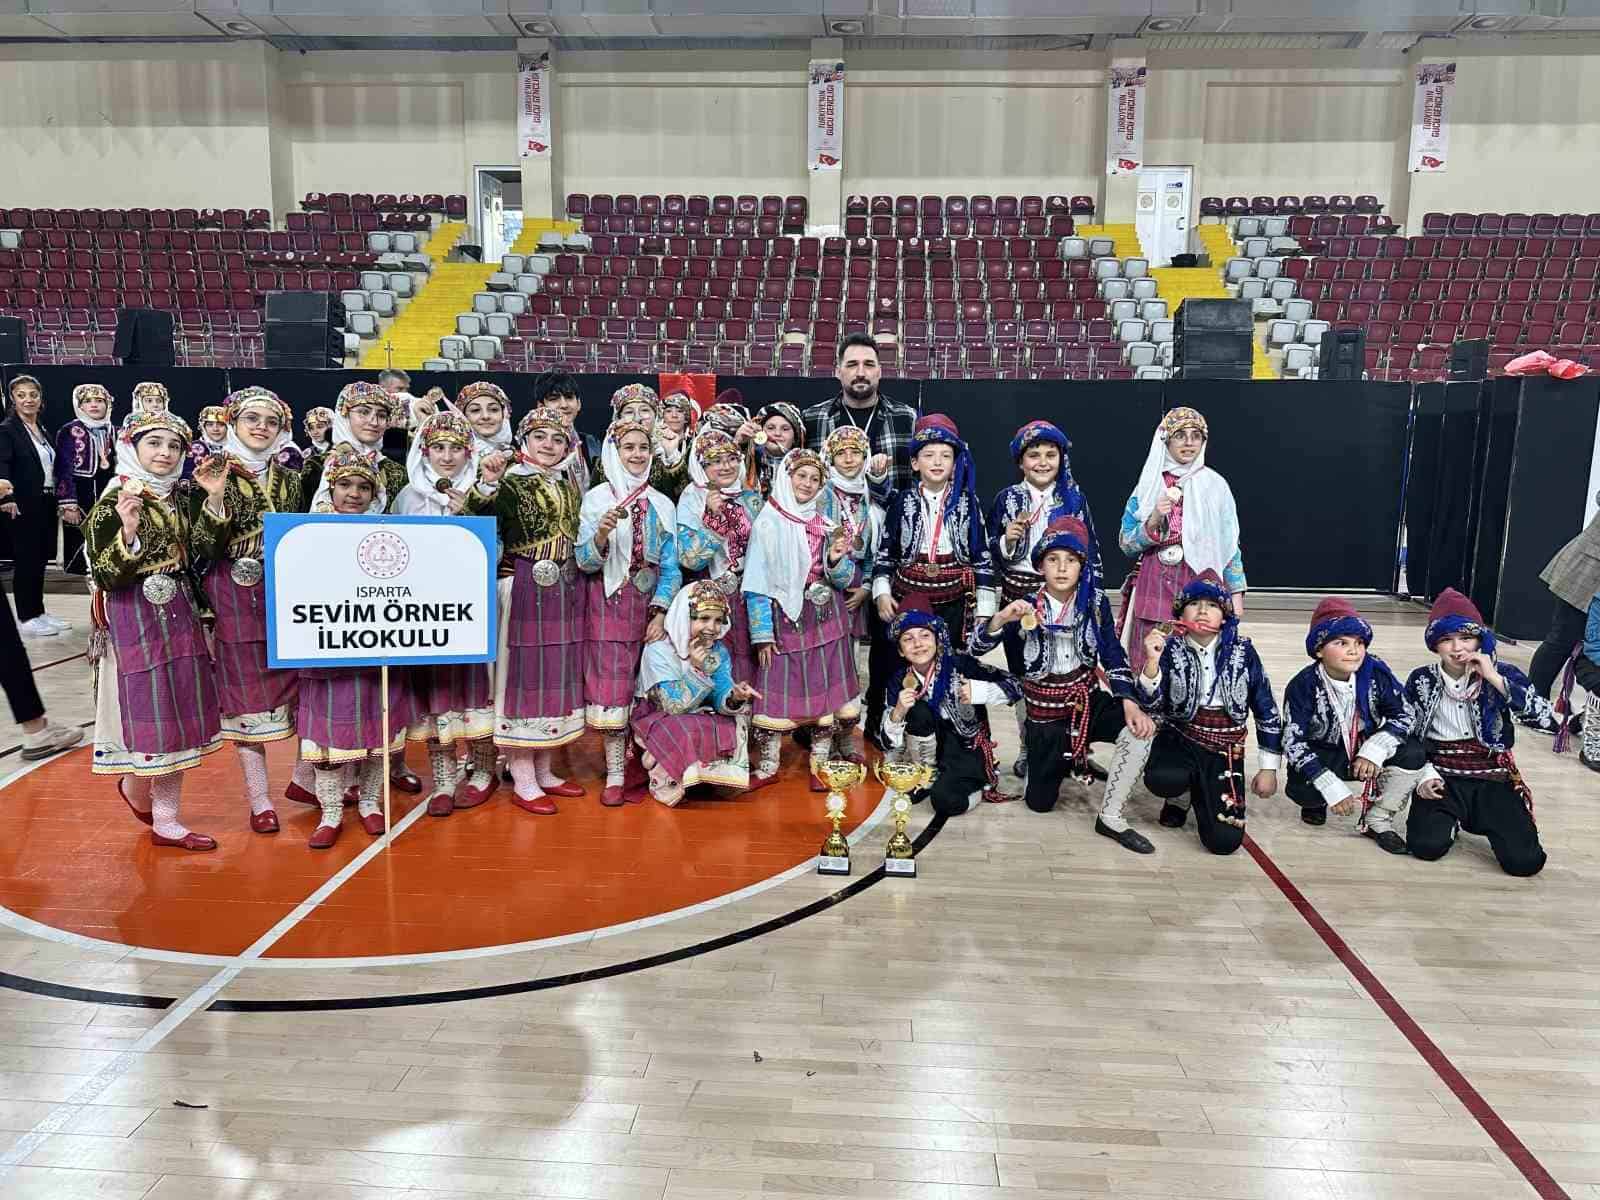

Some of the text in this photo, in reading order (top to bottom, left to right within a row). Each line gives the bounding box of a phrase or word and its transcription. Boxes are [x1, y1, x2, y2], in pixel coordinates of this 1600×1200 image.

[356, 586, 412, 598] ISPARTA
[292, 600, 474, 624] SEVİM ÖRNEK
[318, 626, 449, 649] İLKOKULU
